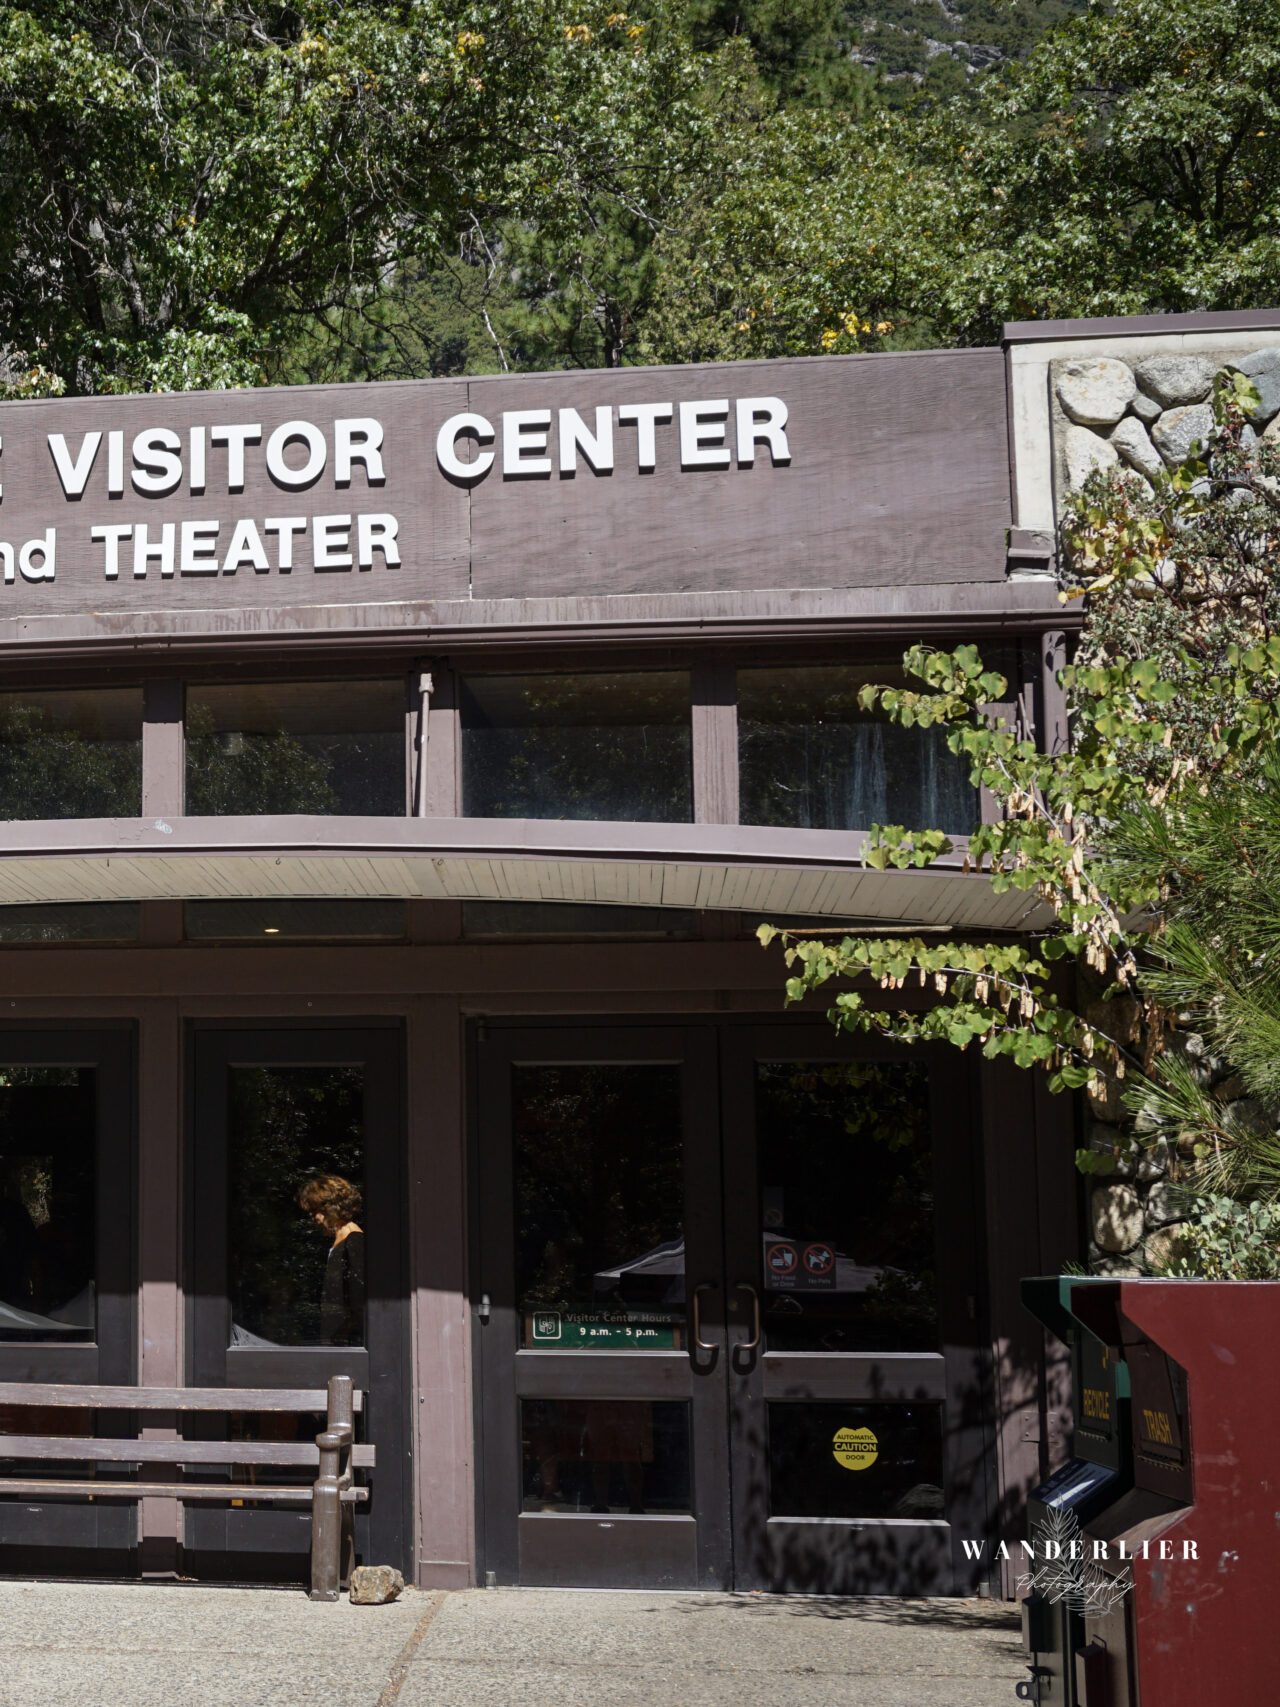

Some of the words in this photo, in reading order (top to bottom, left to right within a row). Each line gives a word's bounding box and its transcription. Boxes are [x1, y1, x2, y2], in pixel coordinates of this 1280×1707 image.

[47, 417, 387, 495] VISITOR
[436, 396, 792, 480] CENTER
[91, 513, 401, 578] THEATER
[566, 1313, 600, 1322] Visitor
[603, 1313, 637, 1322] Center
[641, 1313, 671, 1323] Hours
[579, 1327, 586, 1336] 9
[590, 1328, 612, 1336] a.m.
[625, 1327, 632, 1336] 5
[635, 1329, 658, 1338] p.m.
[1083, 1388, 1111, 1421] RECYCLE
[1142, 1409, 1173, 1445] TRASH
[834, 1442, 877, 1452] CAUTION
